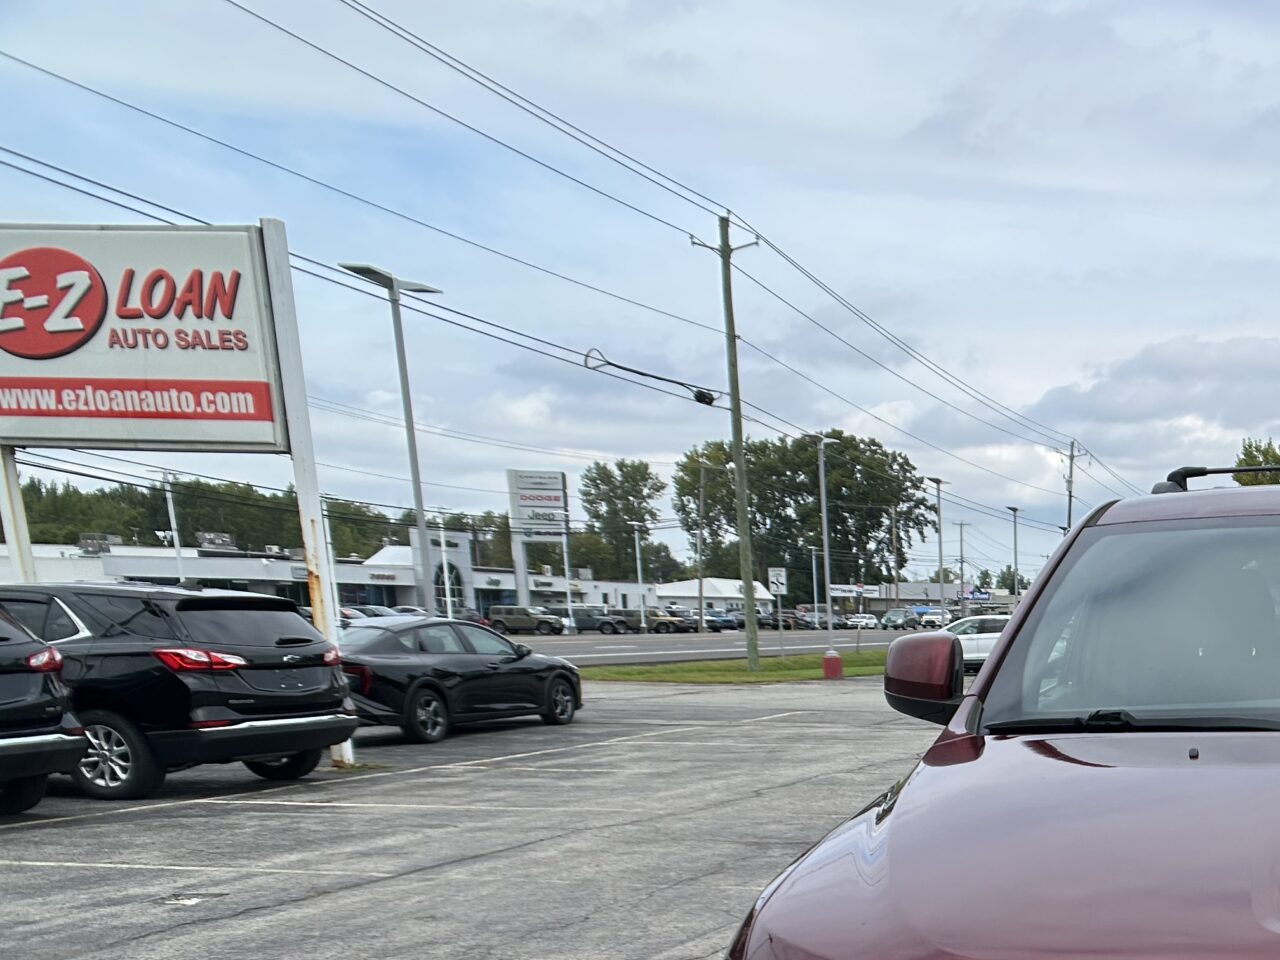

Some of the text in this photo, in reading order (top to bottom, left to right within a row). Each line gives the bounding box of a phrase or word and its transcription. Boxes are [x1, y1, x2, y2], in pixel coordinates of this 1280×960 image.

[0, 266, 241, 333] E-Z LOAN
[108, 327, 249, 351] AUTO SALES
[0, 384, 255, 414] www.ezloanauto.com
[519, 494, 561, 502] DODGE
[527, 509, 556, 522] Jeep
